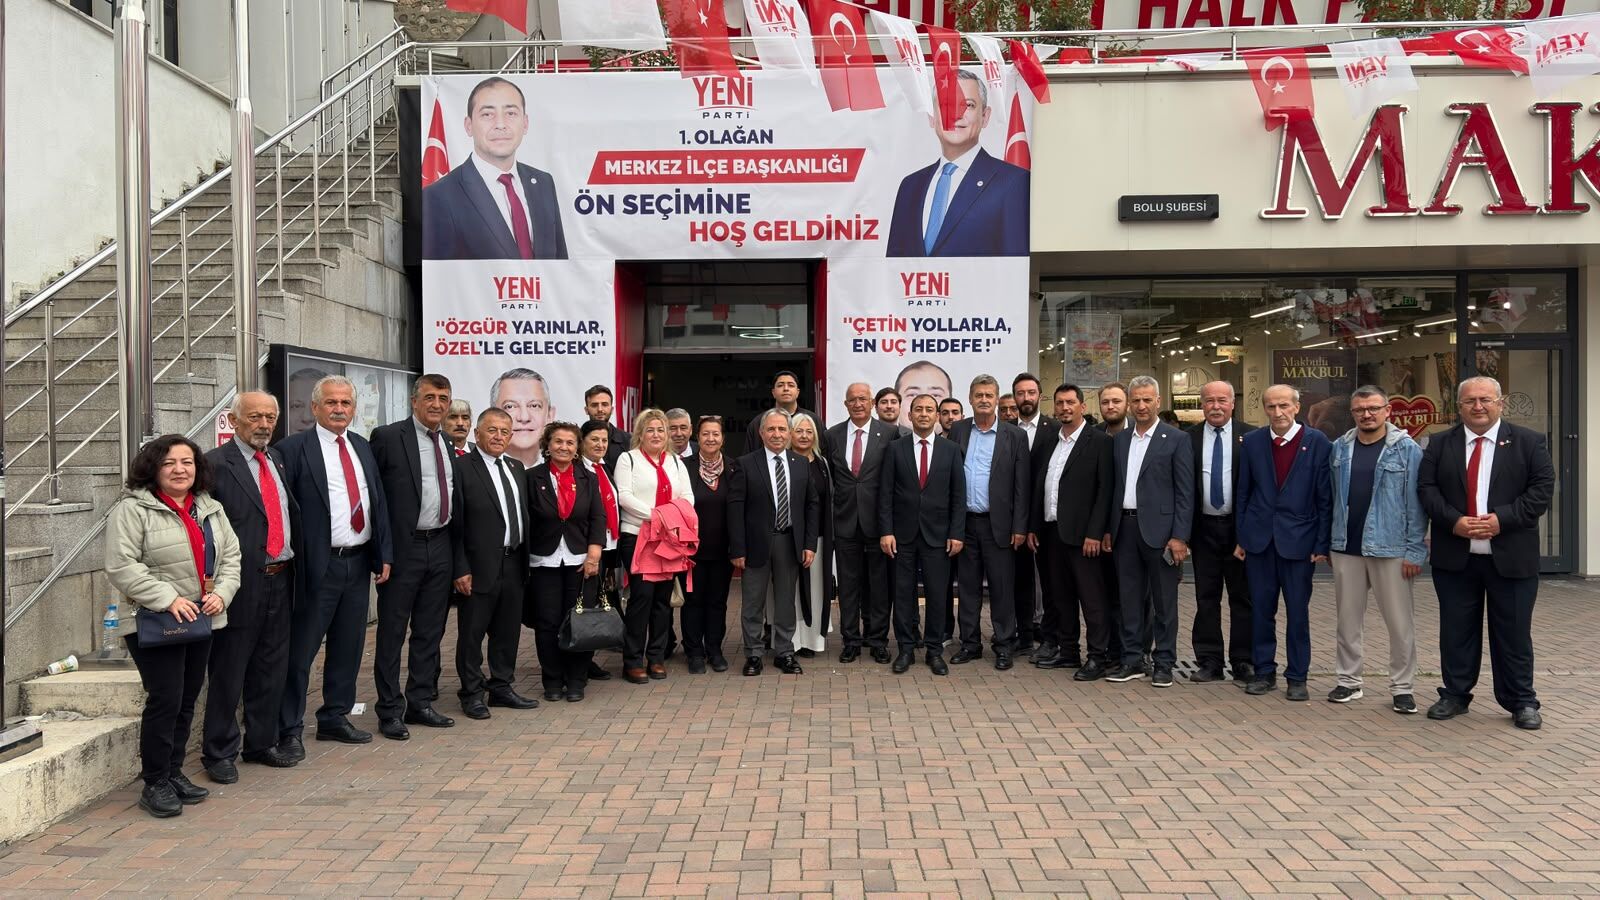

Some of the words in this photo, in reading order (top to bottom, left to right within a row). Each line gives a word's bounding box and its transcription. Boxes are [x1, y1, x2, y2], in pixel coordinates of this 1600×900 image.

[694, 126, 774, 145] OLAĞAN
[605, 159, 682, 176] MERKEZ
[686, 156, 729, 178] İLÇE
[733, 154, 848, 178] BAŞKANLIĞI
[574, 189, 615, 215] ÖN
[622, 188, 751, 220] SEÇİMİNE
[1133, 203, 1164, 212] BOLU
[1165, 200, 1207, 213] ŞUBESİ
[690, 220, 747, 247] HOŞ
[753, 214, 879, 242] GELDİNİZ
[511, 320, 604, 337] YARINLAR,
[911, 317, 1012, 334] YOLLARLA,
[852, 339, 877, 353] EN
[881, 339, 907, 357] UÇ
[1282, 366, 1348, 379] MAKBUL
[1386, 412, 1443, 427] AKBUL
